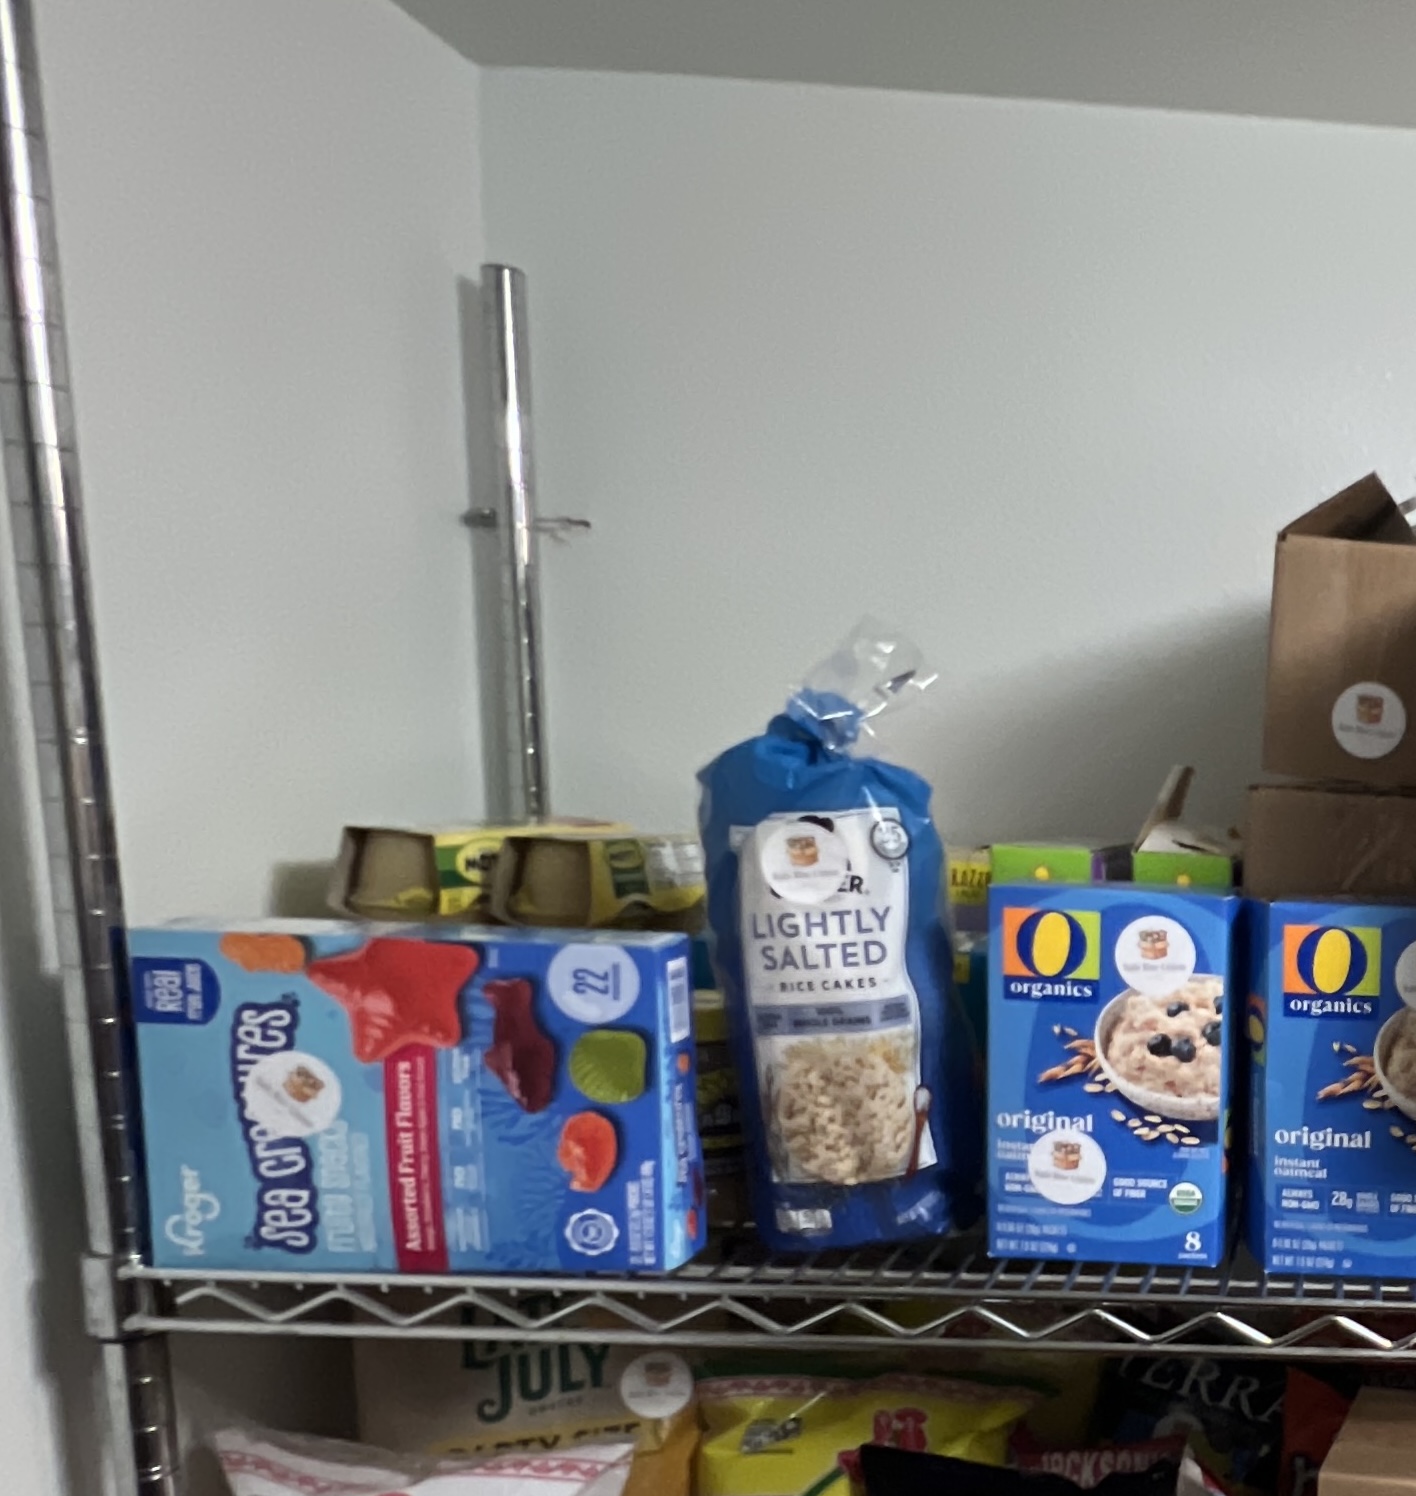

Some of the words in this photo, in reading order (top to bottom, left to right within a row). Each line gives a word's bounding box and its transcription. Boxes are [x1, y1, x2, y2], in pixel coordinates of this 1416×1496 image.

[752, 905, 891, 940] LIGHTLY
[762, 940, 888, 972] SALTED
[573, 967, 610, 995] 22
[779, 980, 816, 993] RICE
[821, 977, 878, 992] CAKES
[1009, 978, 1093, 999] organics
[1289, 997, 1373, 1017] organics
[396, 1061, 413, 1127] Flavors
[996, 1110, 1094, 1134] original
[398, 1132, 416, 1174] Fruit
[1274, 1125, 1372, 1151] original
[1273, 1155, 1321, 1168] instant
[165, 1163, 221, 1256] Kroger
[259, 1188, 313, 1247] sea
[400, 1178, 423, 1252] Assorted
[1184, 1230, 1202, 1252] 8
[476, 1342, 611, 1424] JULY
